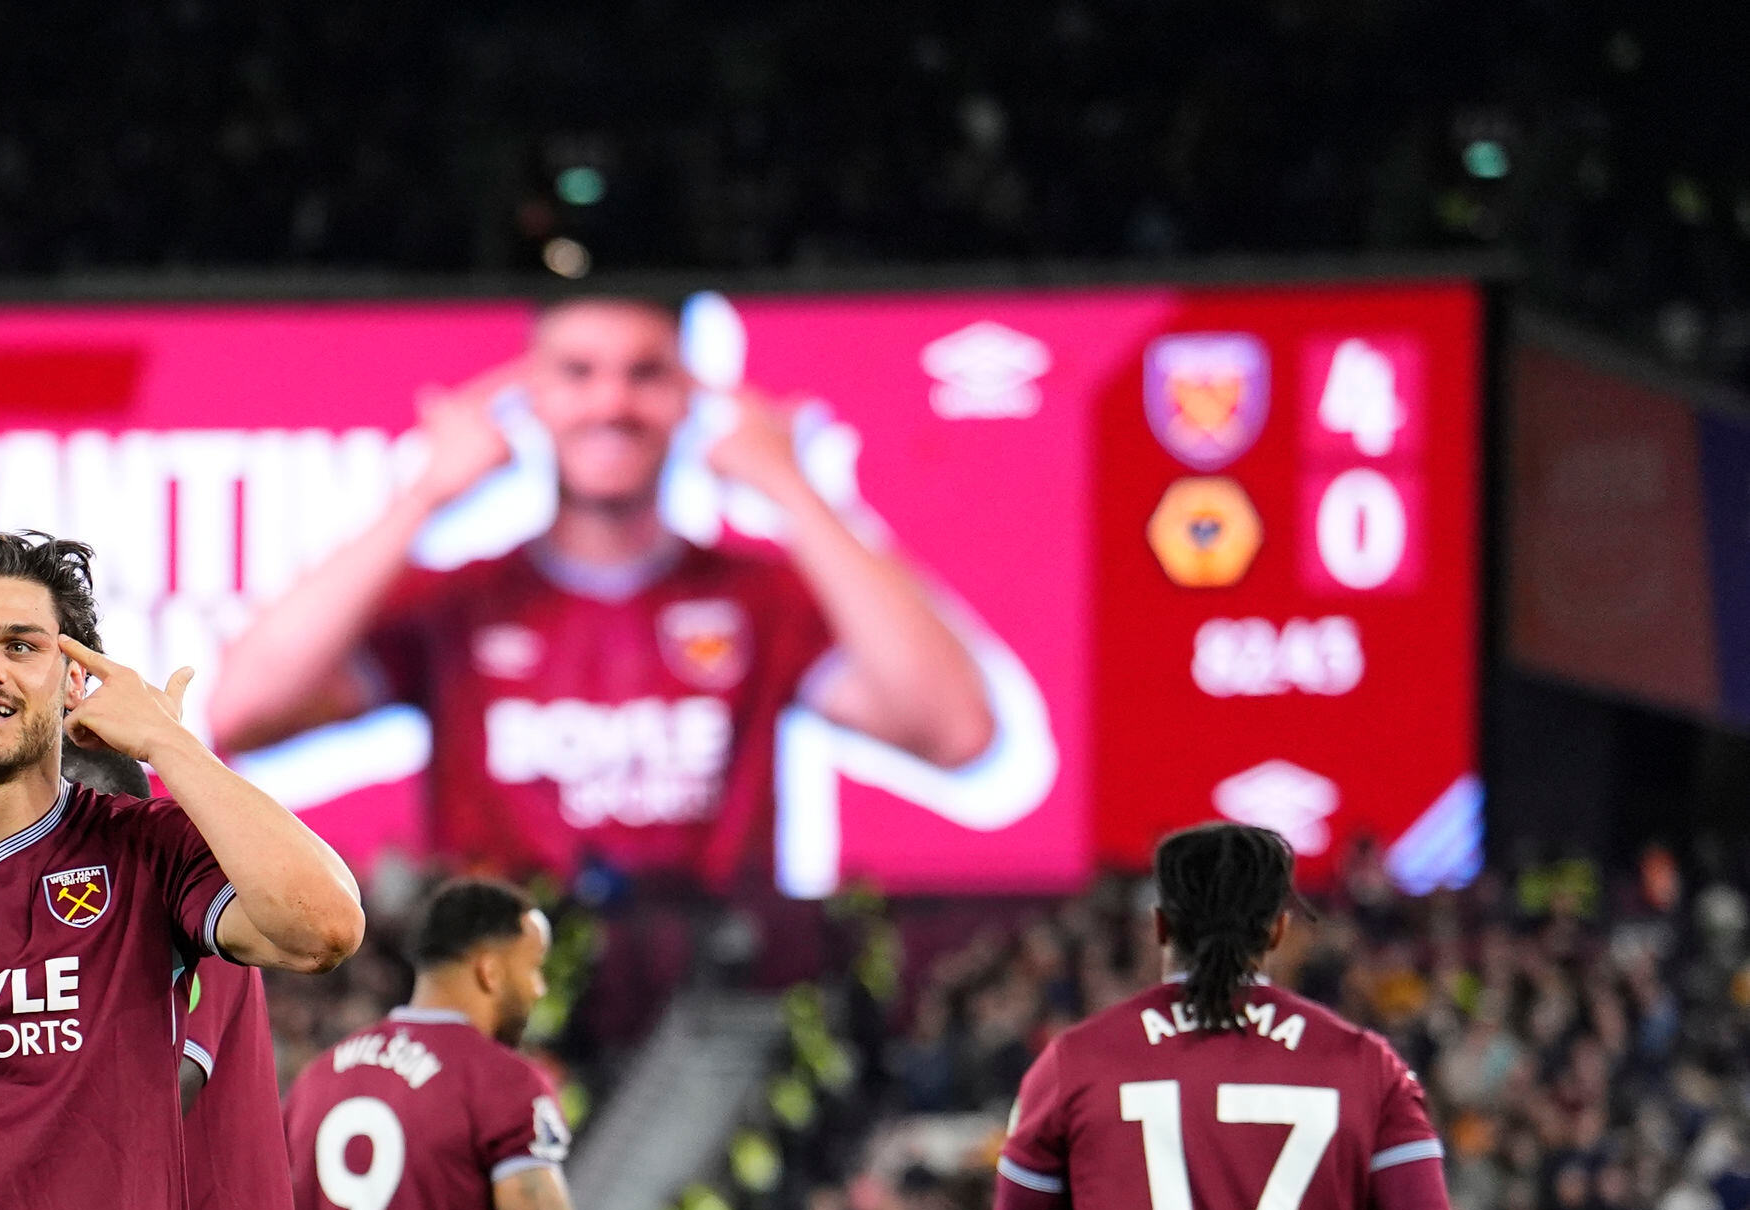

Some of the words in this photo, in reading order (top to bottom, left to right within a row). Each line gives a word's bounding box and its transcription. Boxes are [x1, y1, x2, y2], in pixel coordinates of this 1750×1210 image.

[1317, 338, 1407, 457] 4
[1315, 467, 1408, 590] 0
[50, 872, 76, 885] WEST
[77, 869, 101, 878] HAM
[61, 875, 91, 886] UNITED
[333, 1033, 442, 1090] WILSON
